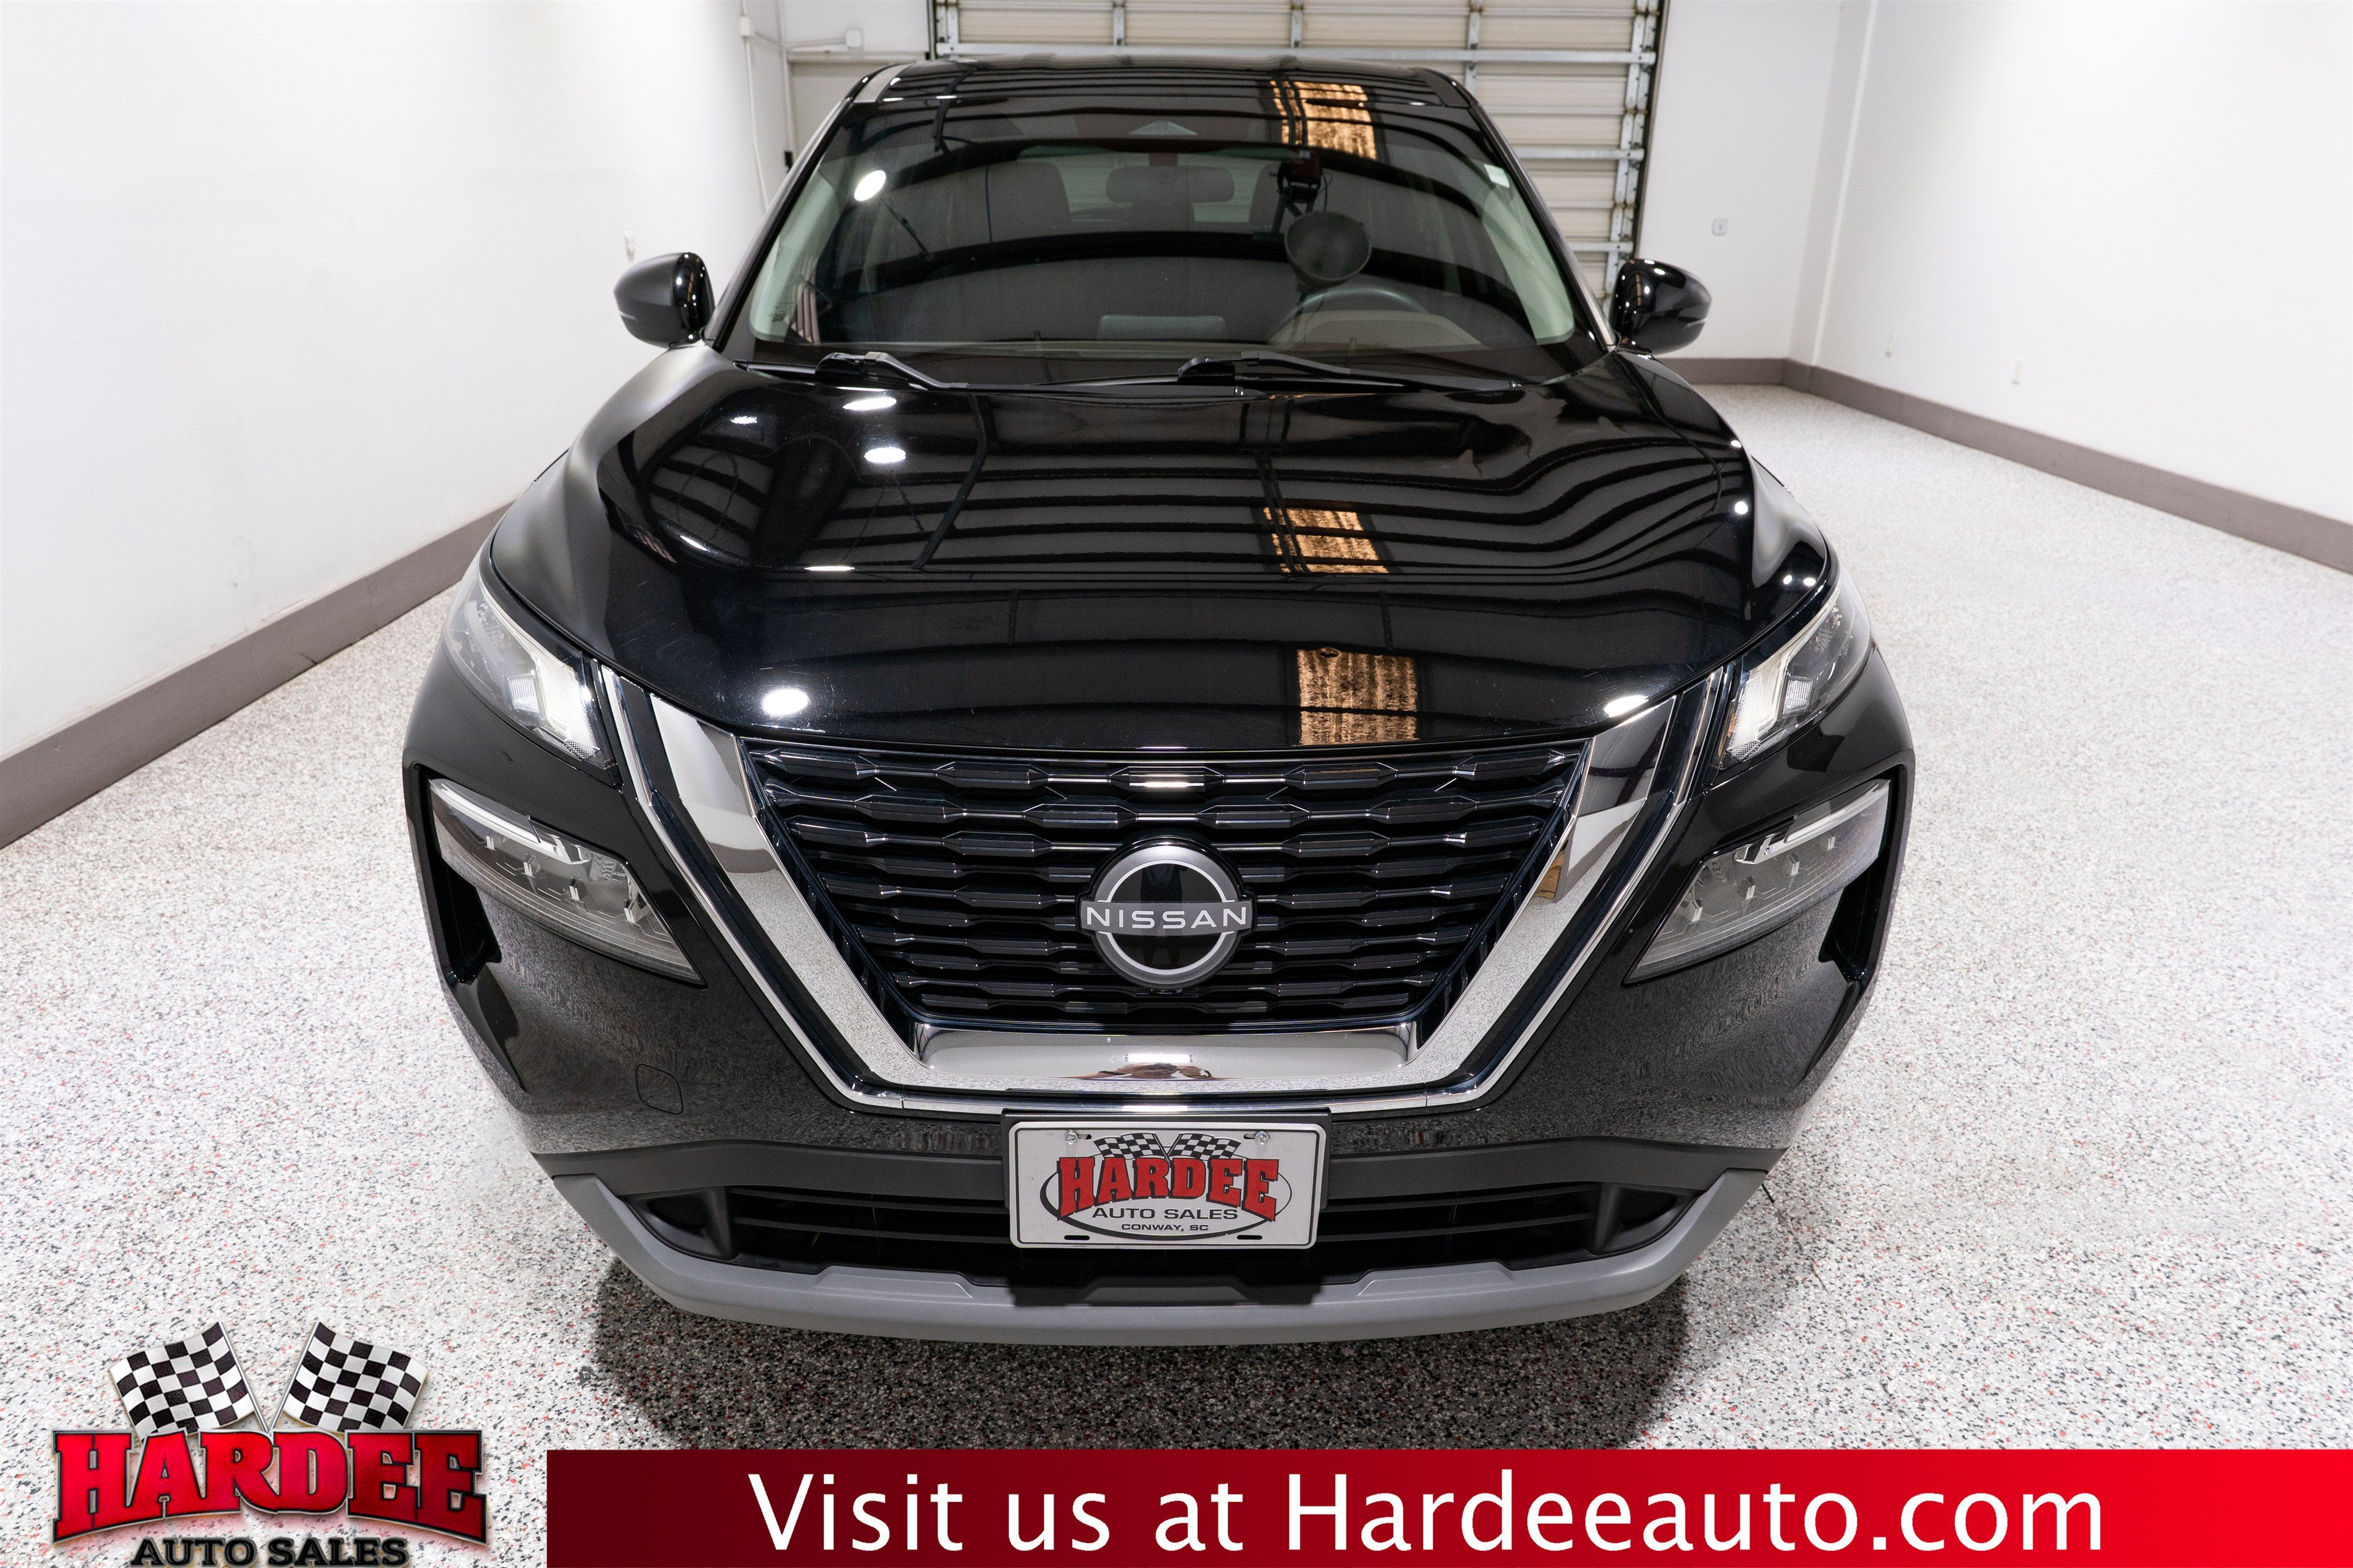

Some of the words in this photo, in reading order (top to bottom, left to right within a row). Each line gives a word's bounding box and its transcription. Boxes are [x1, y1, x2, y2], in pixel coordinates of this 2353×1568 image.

[1086, 906, 1247, 929] NISSAN
[1057, 1157, 1279, 1222] HARDEE
[1091, 1207, 1155, 1219] AUTO
[1164, 1208, 1238, 1220] SALES
[1121, 1224, 1185, 1232] CONWAY,
